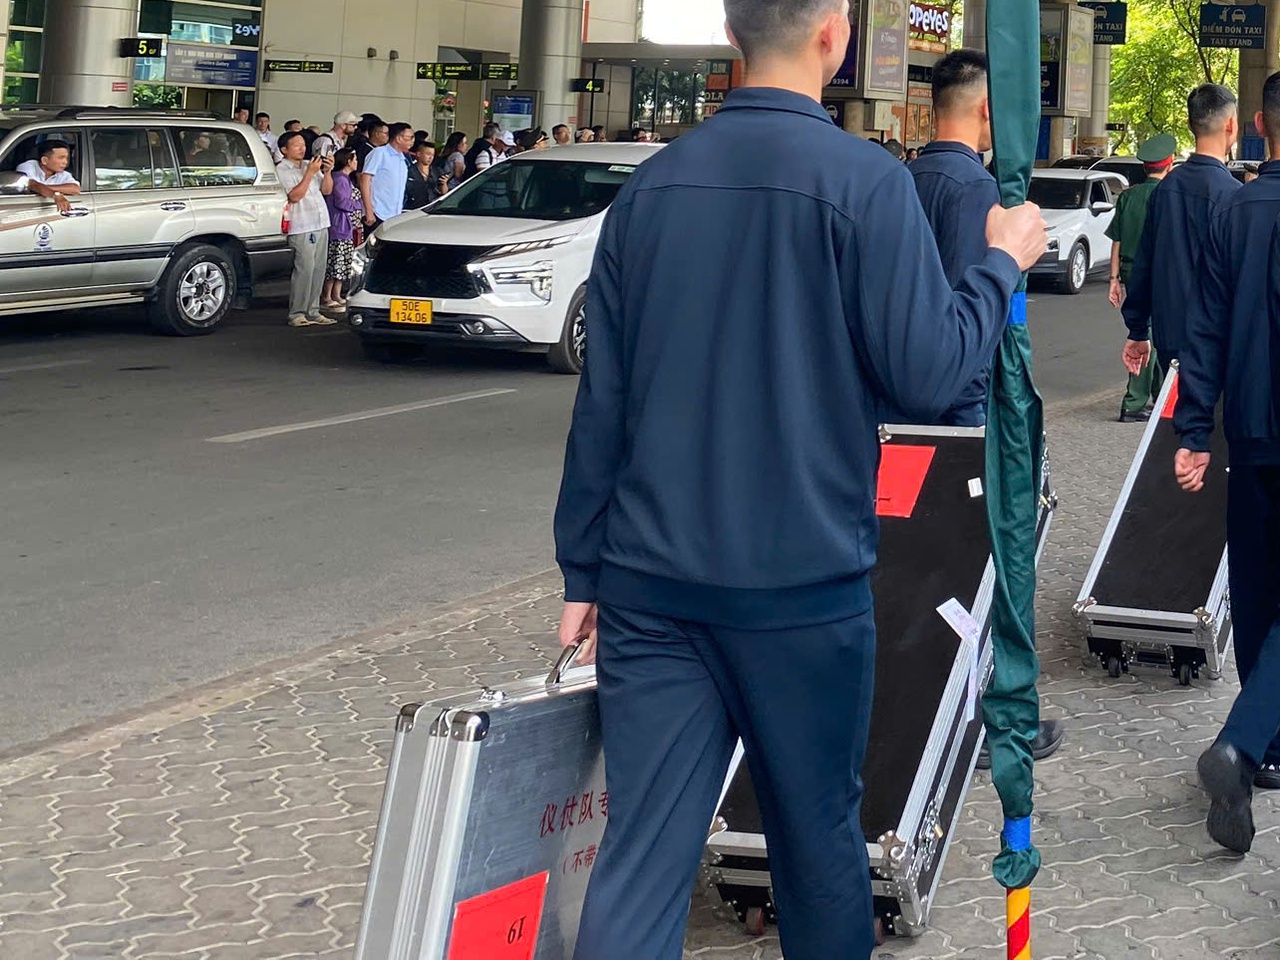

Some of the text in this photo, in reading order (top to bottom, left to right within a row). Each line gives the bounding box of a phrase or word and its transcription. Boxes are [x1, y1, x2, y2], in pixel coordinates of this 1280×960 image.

[1243, 26, 1262, 34] TAXI
[1093, 34, 1113, 42] TAND
[1210, 37, 1252, 46] TAXI STAND
[138, 40, 148, 55] 5
[586, 80, 594, 91] 4
[402, 300, 420, 311] 50E
[395, 311, 428, 323] 134.06
